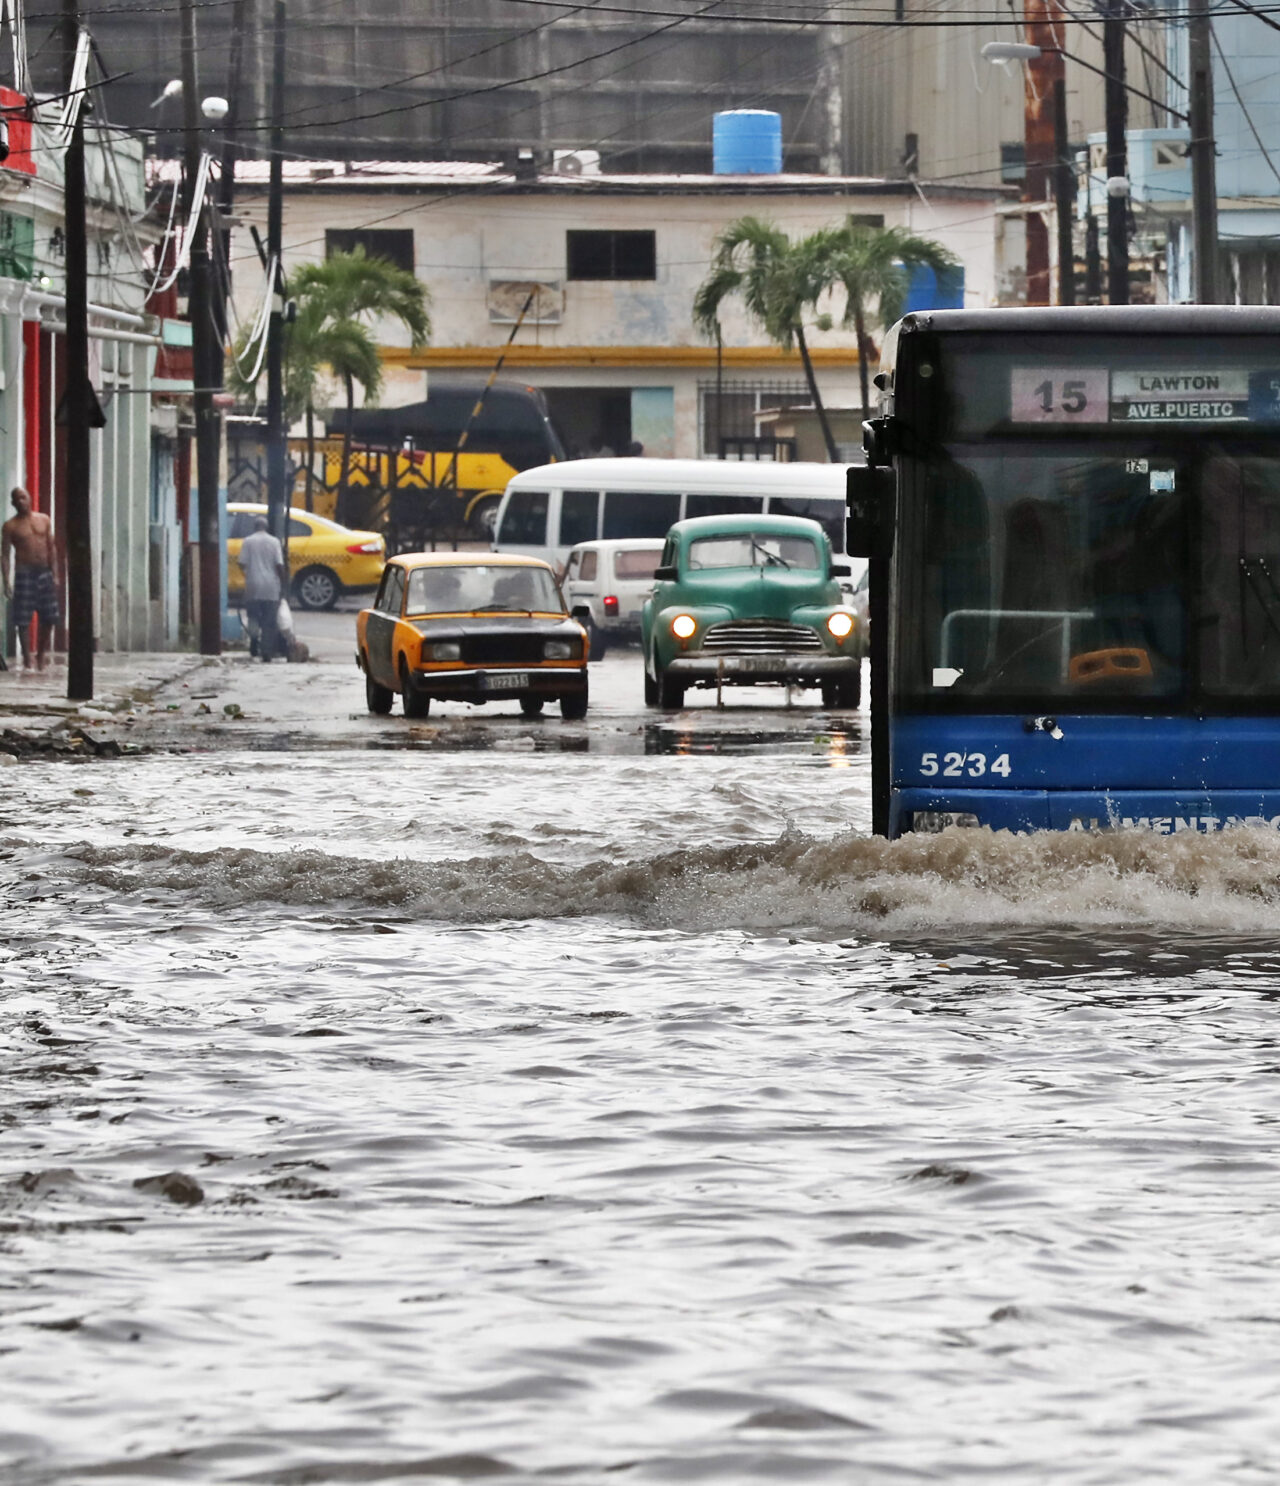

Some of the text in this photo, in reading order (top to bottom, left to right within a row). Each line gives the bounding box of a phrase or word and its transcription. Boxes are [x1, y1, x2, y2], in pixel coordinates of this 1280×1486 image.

[1139, 375, 1219, 391] LAWTON
[1034, 380, 1087, 413] 15
[919, 752, 1012, 778] 5234
